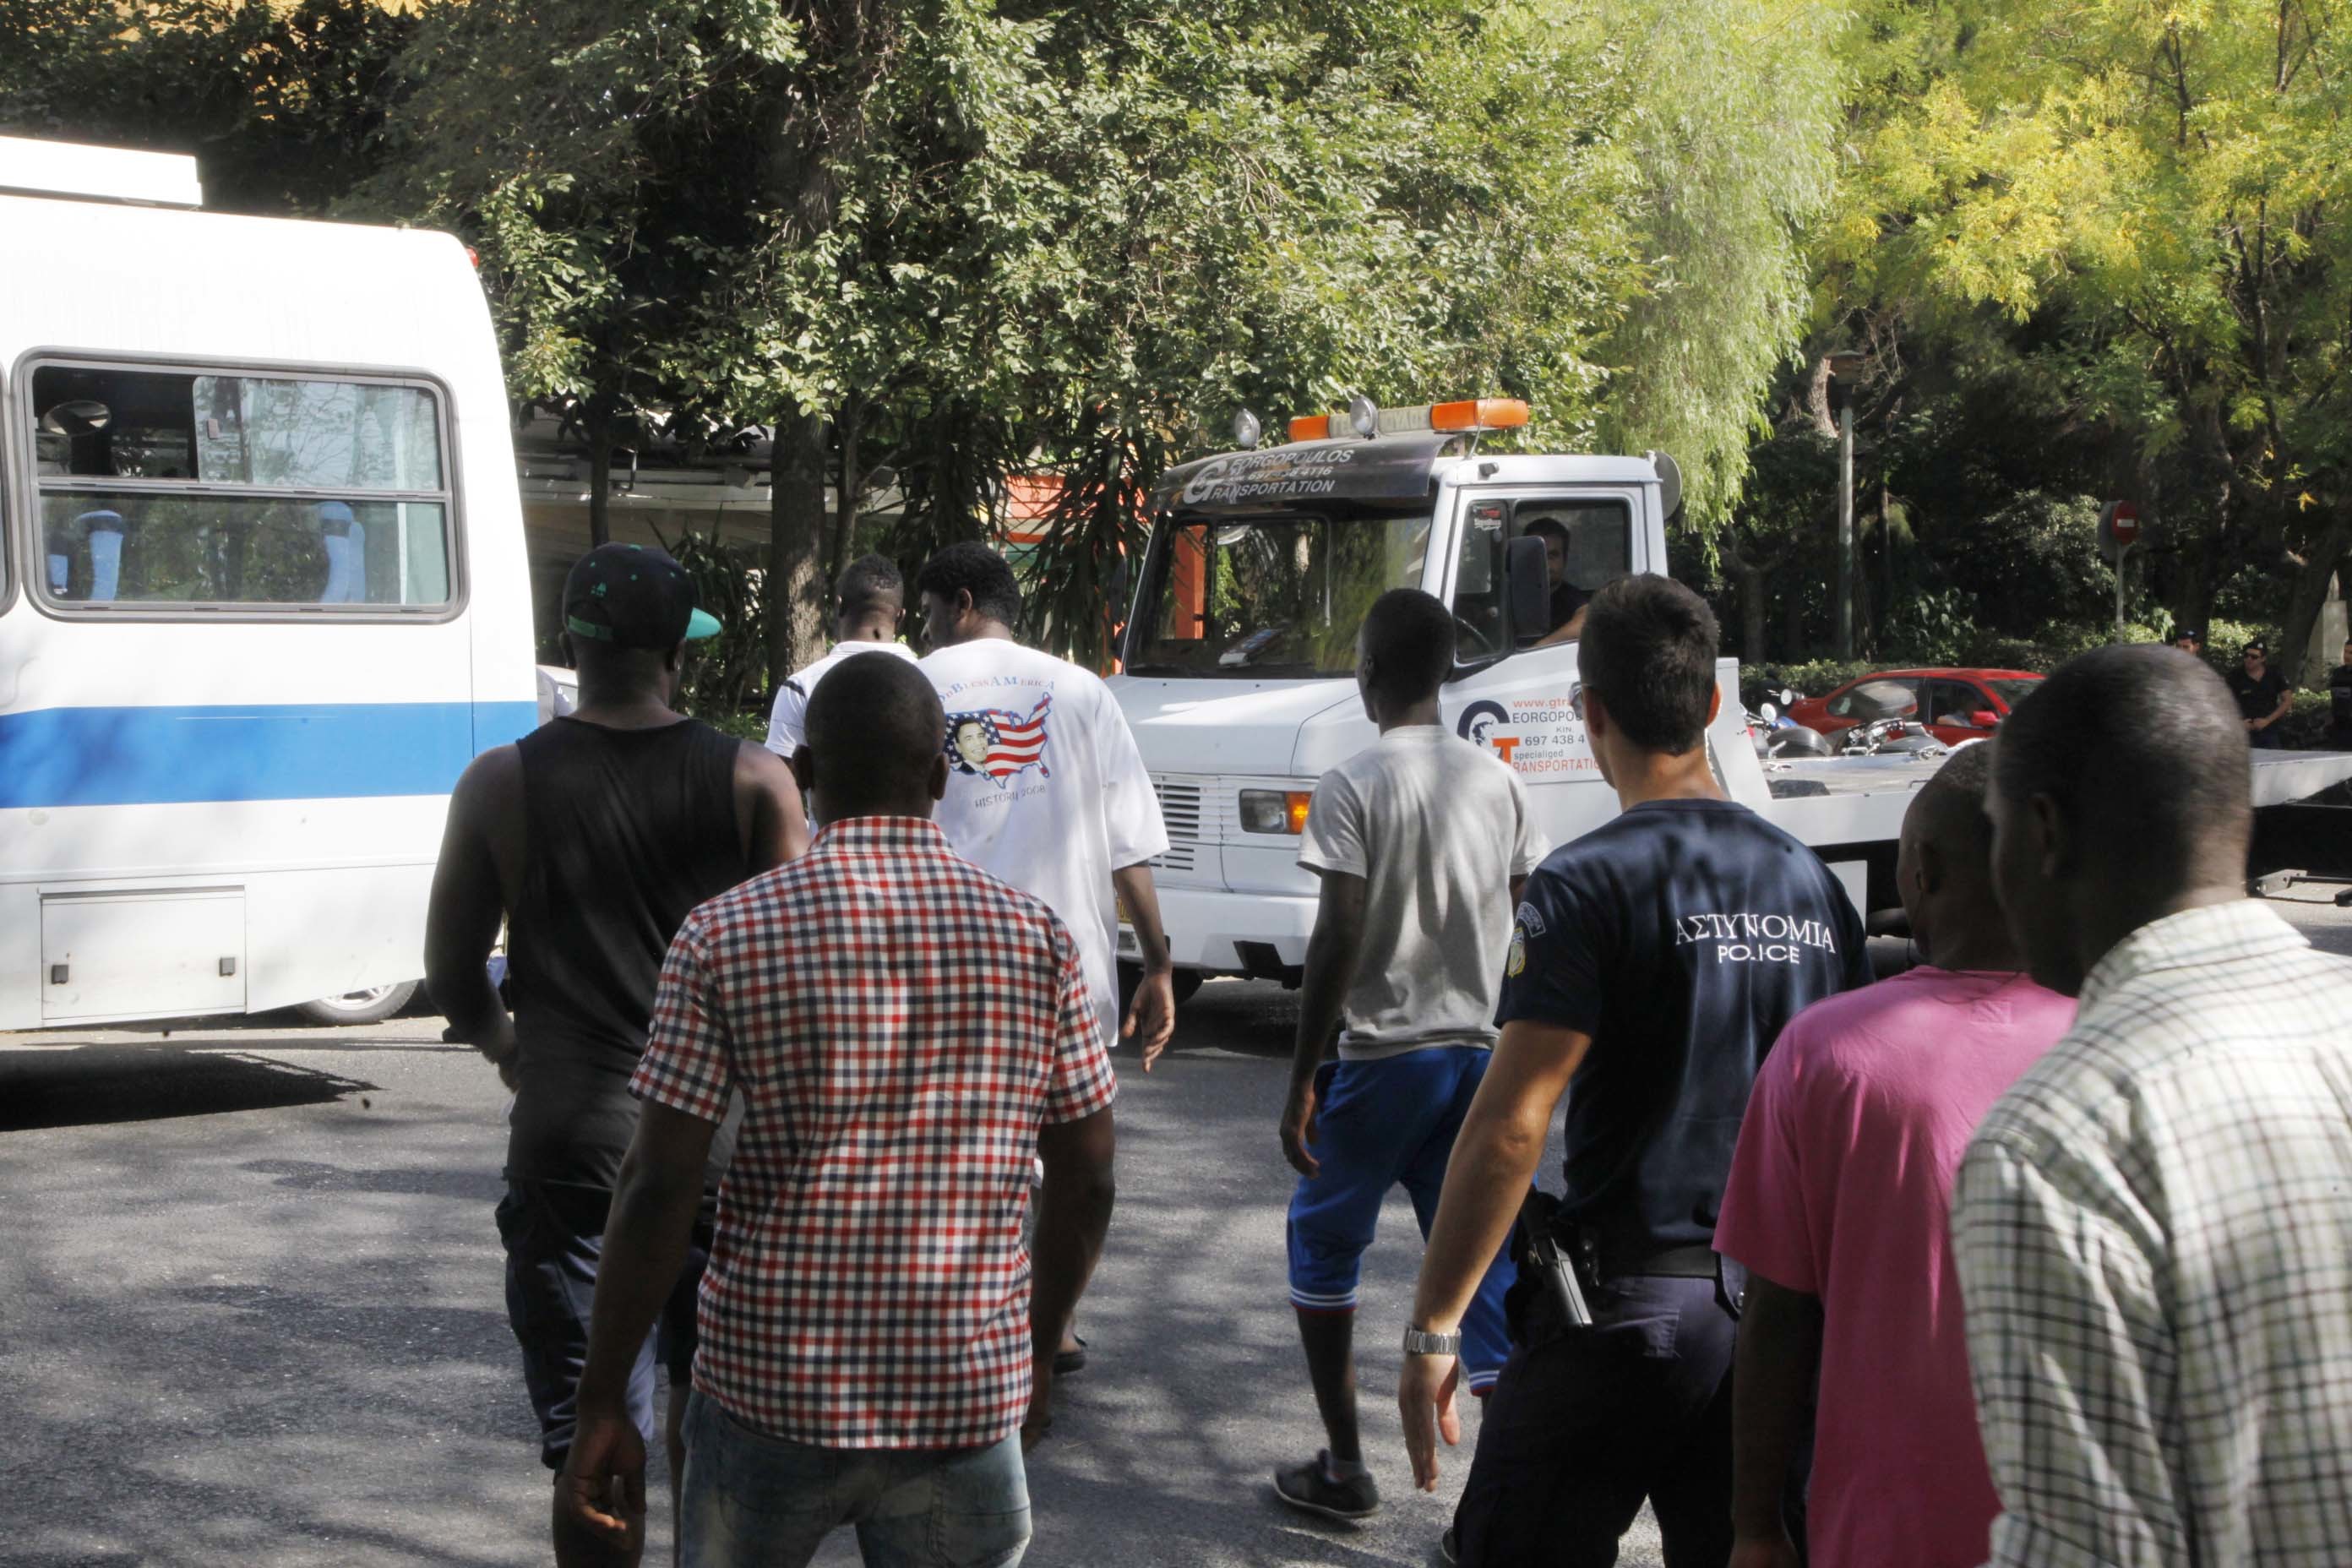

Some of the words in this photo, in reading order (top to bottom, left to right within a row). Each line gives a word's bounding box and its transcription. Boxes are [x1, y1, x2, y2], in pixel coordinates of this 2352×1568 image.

[1524, 736, 1548, 747] 697
[1551, 734, 1574, 745] 438
[1675, 912, 1837, 953] ΑΣΤΥΝΟΜΙΑ
[1718, 944, 1800, 964] POLICE
